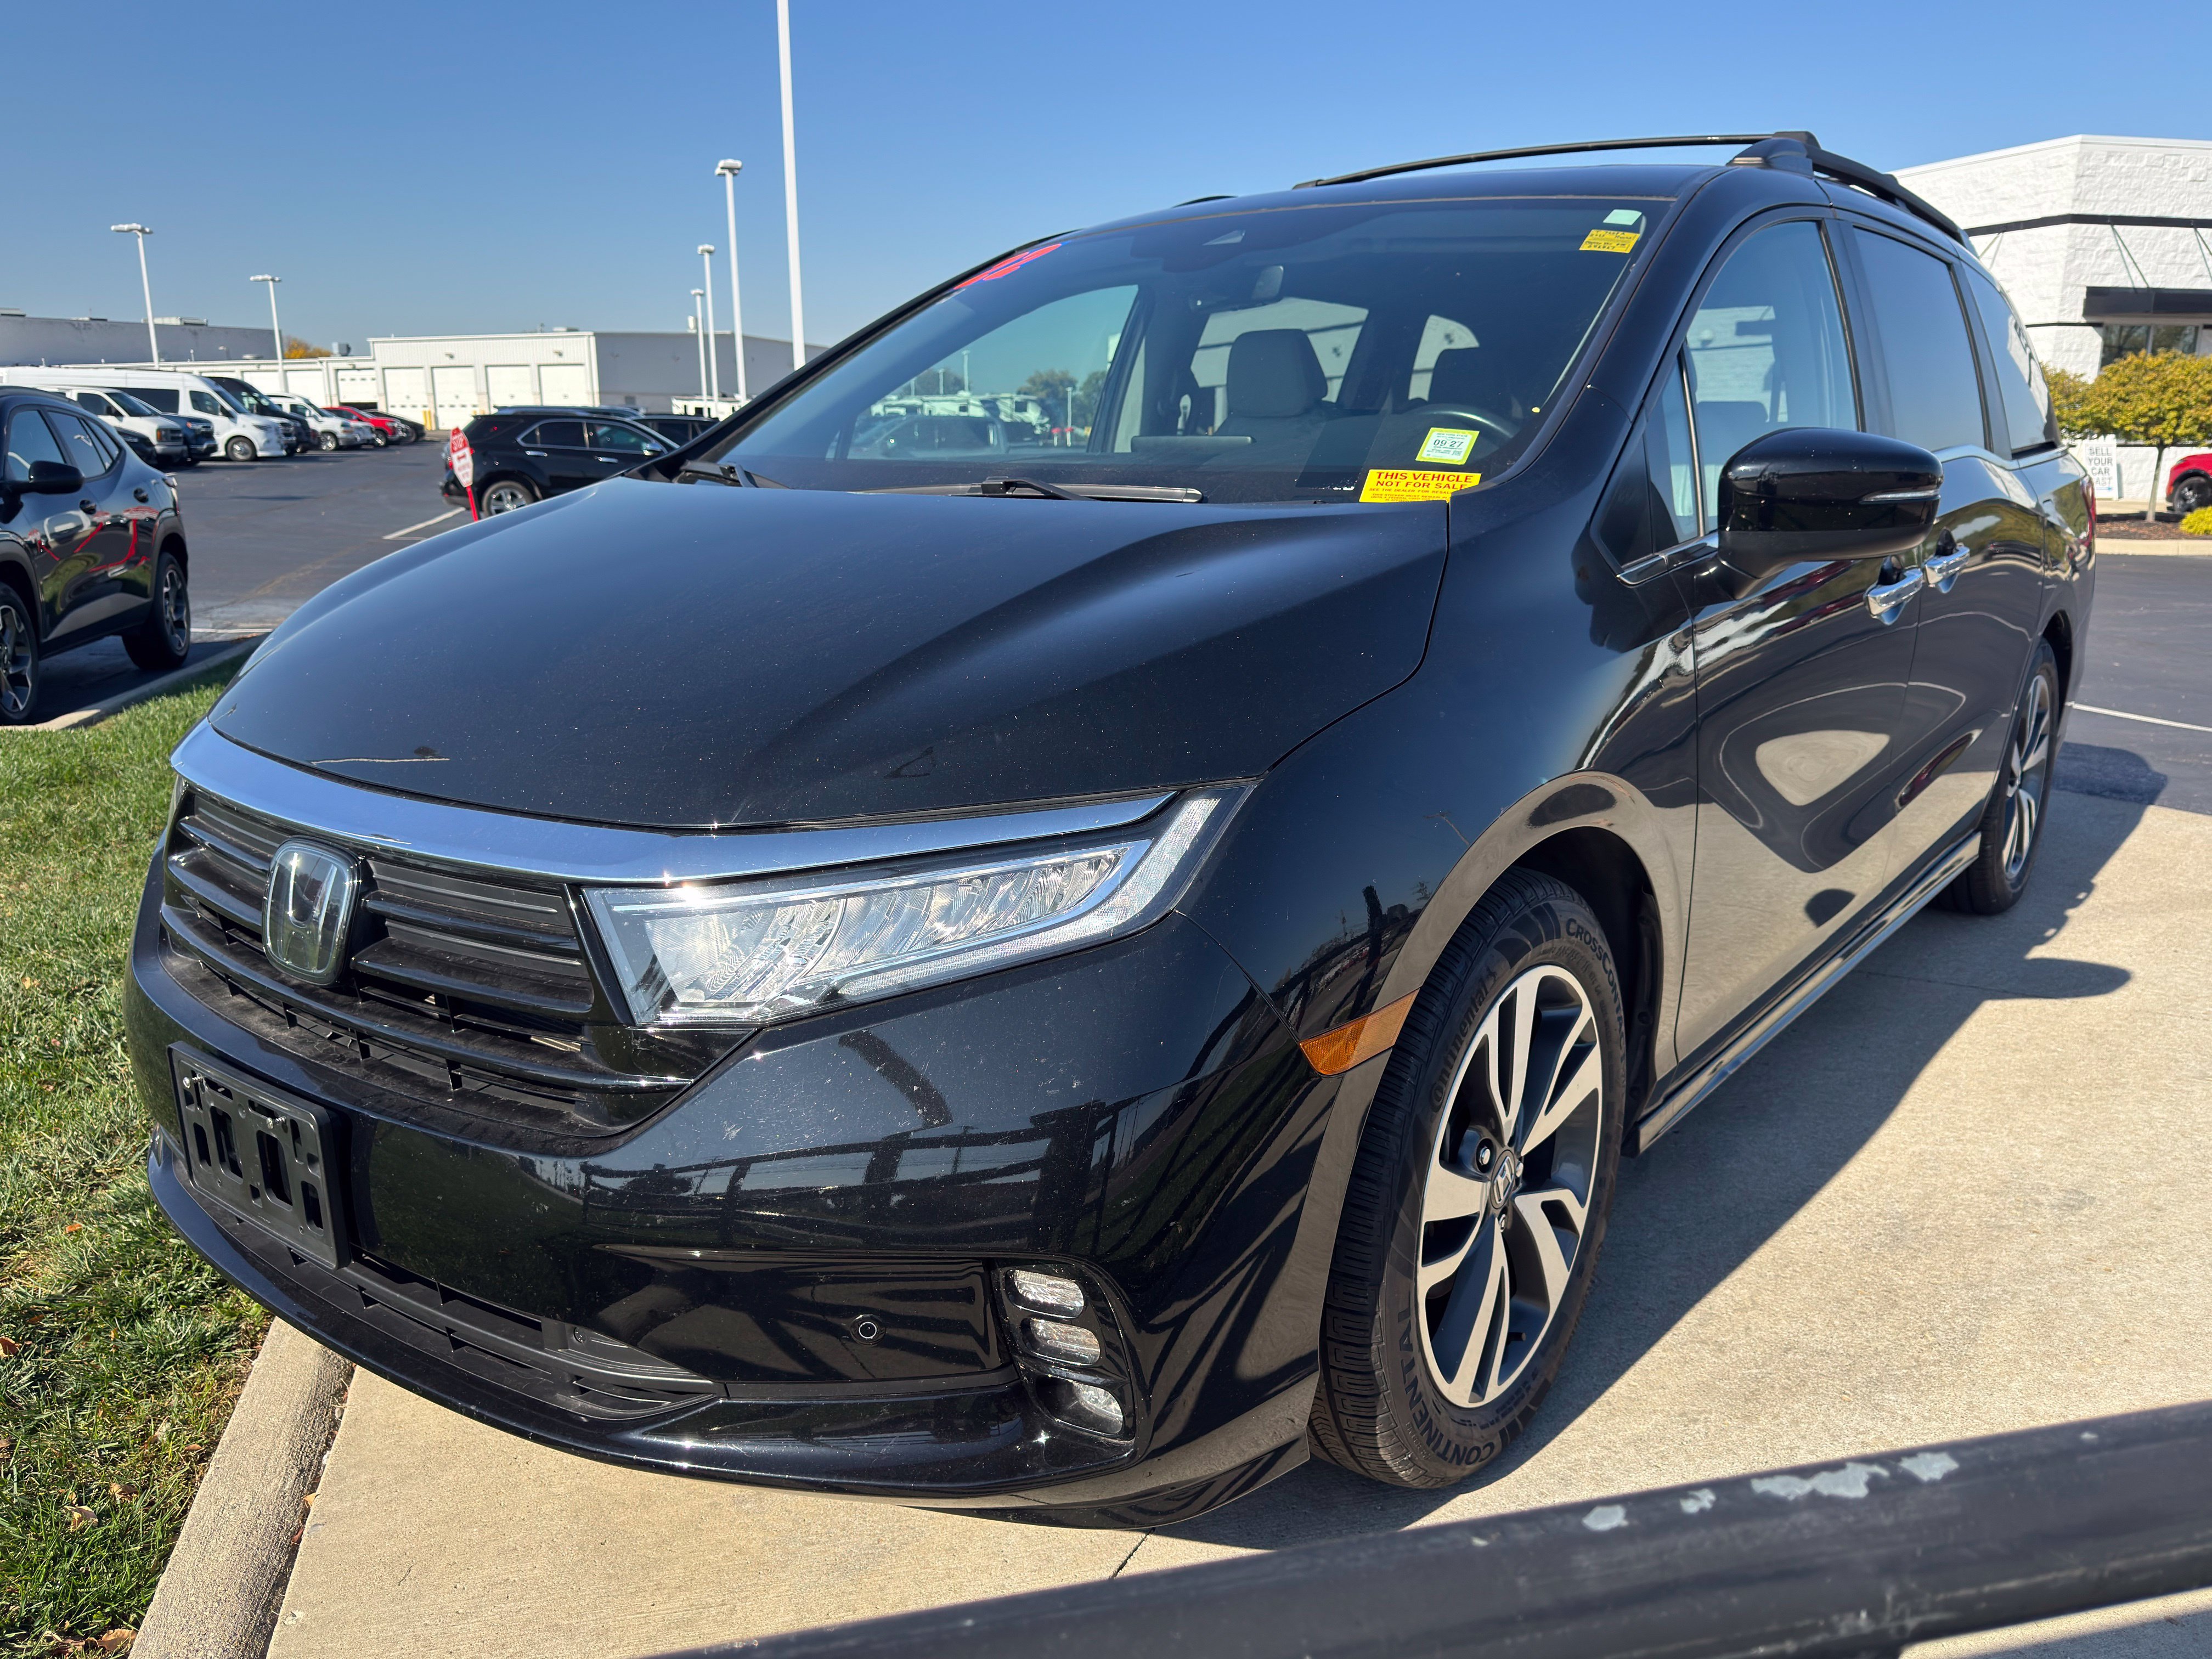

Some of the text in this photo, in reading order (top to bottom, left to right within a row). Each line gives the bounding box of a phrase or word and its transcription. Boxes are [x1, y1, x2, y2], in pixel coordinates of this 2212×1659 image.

[453, 432, 464, 450] STOP
[2089, 447, 2112, 456] SELL
[2088, 456, 2113, 466] YOUR
[2091, 466, 2110, 476] CAR
[1376, 472, 1474, 483] THIS VEHICLE
[2095, 476, 2113, 486] AST
[1430, 978, 1489, 1113] Continental
[1398, 1291, 1495, 1466] CONTINENTAL
